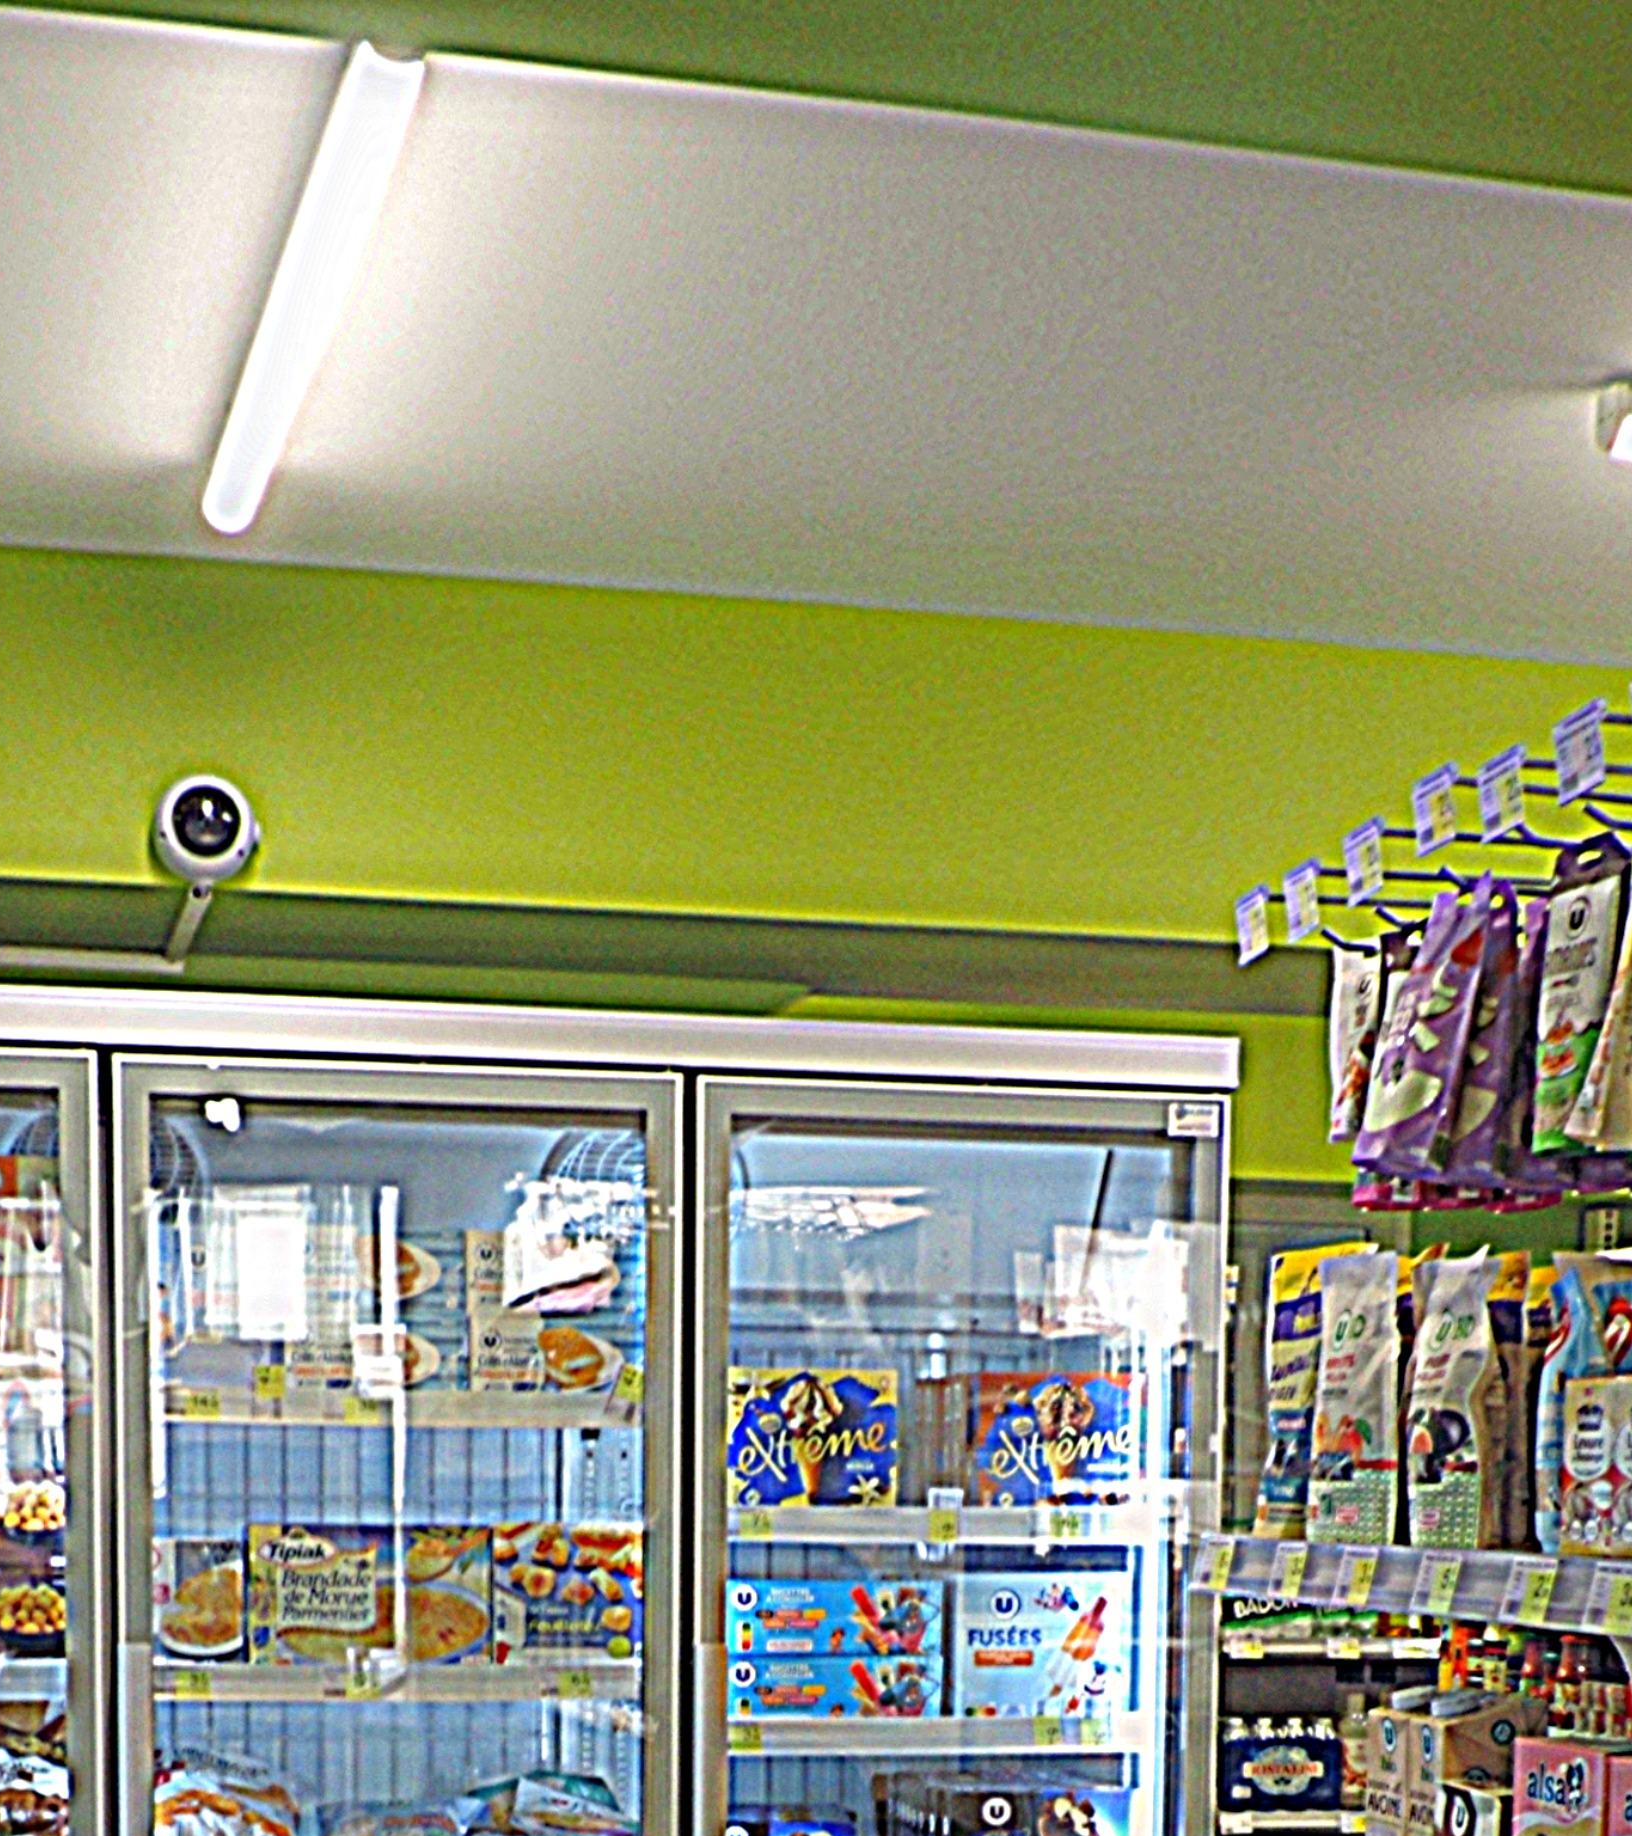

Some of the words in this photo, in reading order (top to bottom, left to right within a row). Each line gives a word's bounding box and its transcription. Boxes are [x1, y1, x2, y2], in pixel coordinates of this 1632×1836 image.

[267, 1542, 326, 1562] Tipiak
[281, 1571, 371, 1591] Brandade
[968, 1626, 1041, 1647] FUSÉES
[1527, 1763, 1565, 1805] alsa
